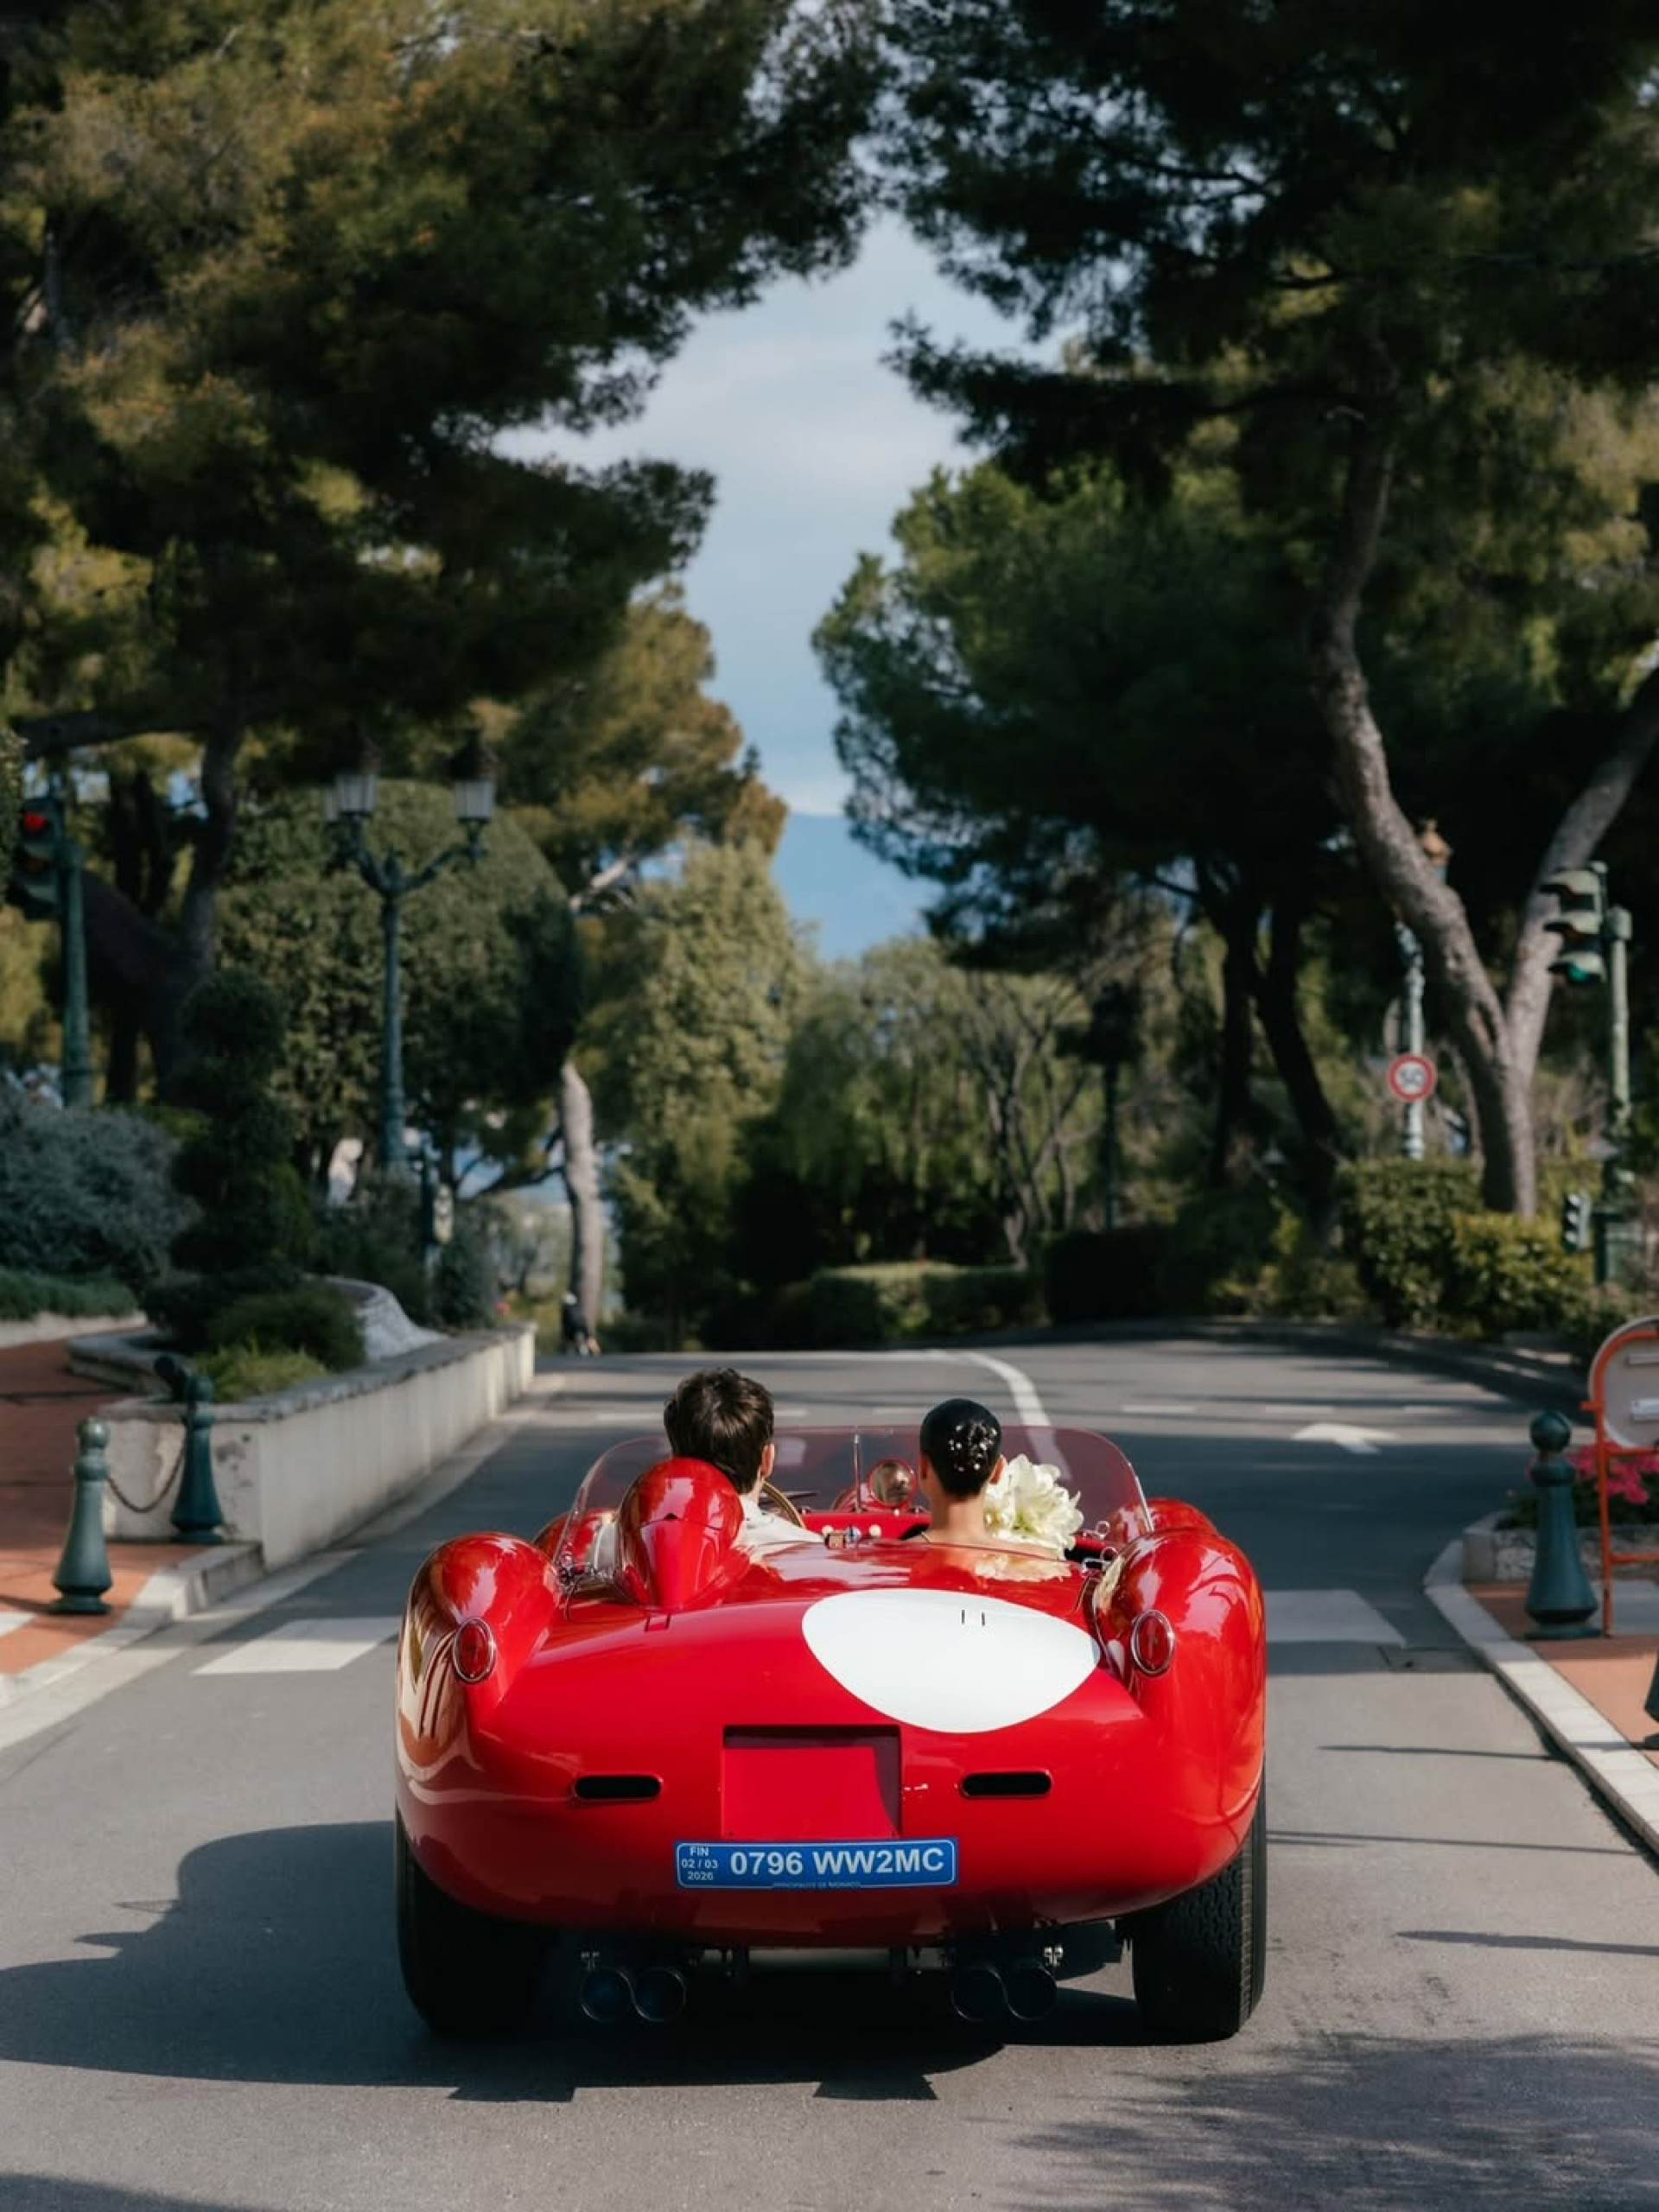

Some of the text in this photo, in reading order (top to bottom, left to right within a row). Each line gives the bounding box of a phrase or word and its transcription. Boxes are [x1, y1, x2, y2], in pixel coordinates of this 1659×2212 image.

[690, 1846, 709, 1856] FIN
[681, 1859, 695, 1868] 02
[704, 1859, 718, 1868] 03
[730, 1847, 944, 1875] 0796 WW2MC
[688, 1871, 714, 1880] 2026
